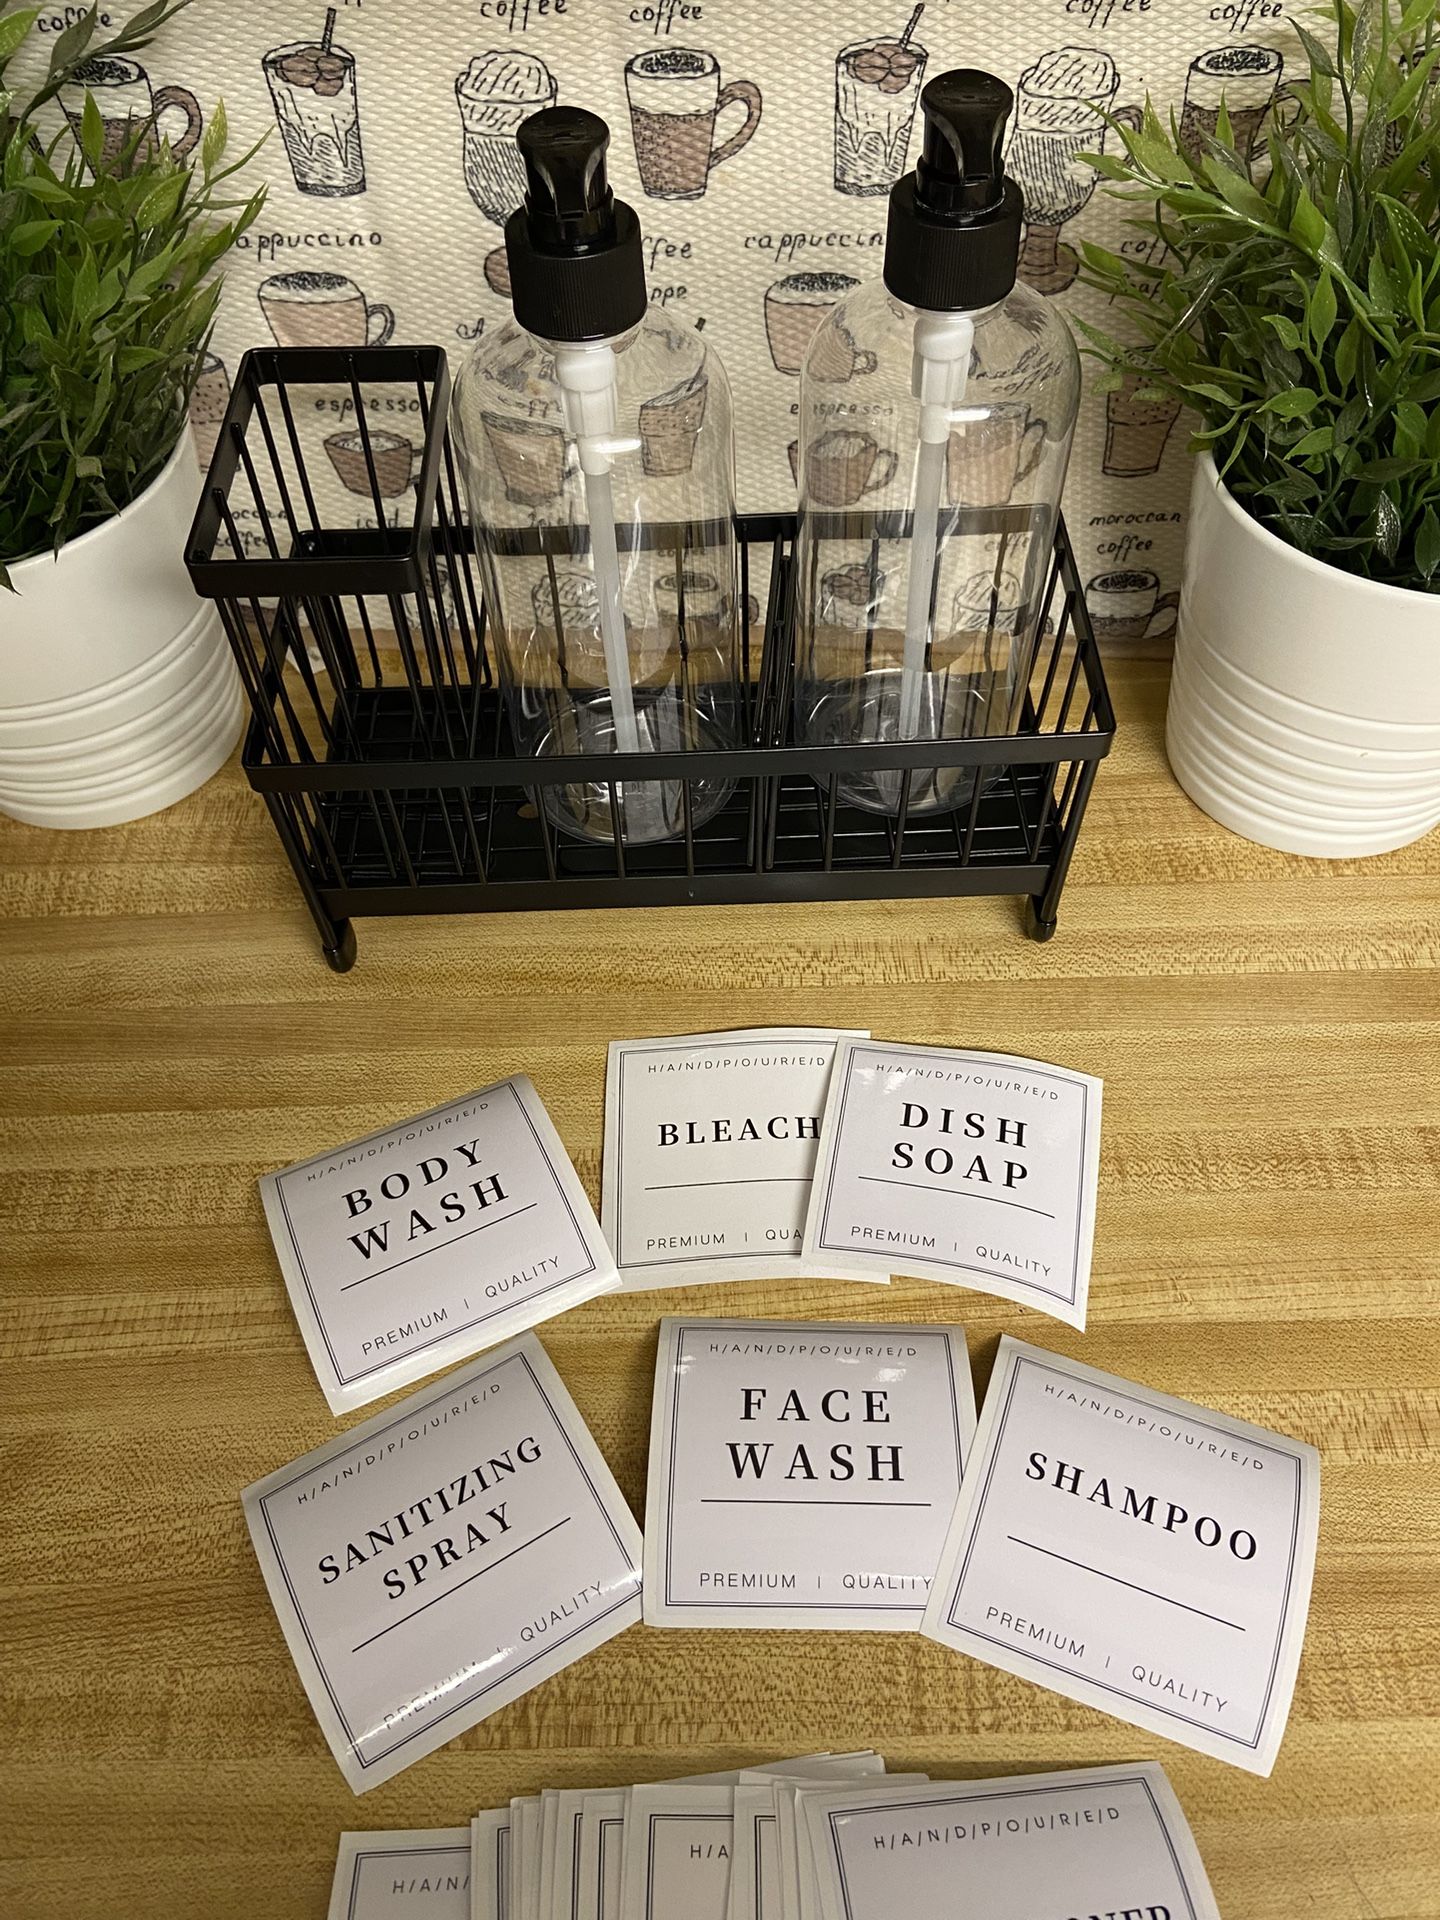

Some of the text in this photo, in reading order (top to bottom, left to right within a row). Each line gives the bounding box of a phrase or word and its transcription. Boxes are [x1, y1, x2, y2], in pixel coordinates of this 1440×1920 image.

[37, 7, 112, 33] cofe
[480, 0, 568, 32] coffee
[629, 0, 703, 35] coffee
[1209, 0, 1283, 33] coffee
[235, 228, 382, 262] appuccino
[744, 229, 884, 263] cappuccin
[314, 398, 420, 422] espesso
[1089, 512, 1181, 526] moroccan
[1096, 535, 1152, 562] coffee
[648, 1056, 825, 1074] H/A/N/D/P/O/U/R/E/D
[657, 1116, 821, 1147] BLEACH
[899, 1102, 1028, 1148] DISH
[342, 1138, 484, 1219] BODY
[891, 1142, 1028, 1189] SOAP
[347, 1173, 509, 1260] WASH
[647, 1233, 726, 1250] PREMIUM
[851, 1226, 1052, 1277] PREMIUM QUALITY
[361, 1256, 560, 1356] PREMIUM QUALITY
[710, 1343, 917, 1358] H/A/N/D/P/O/U/R/E/D
[739, 1388, 890, 1423] FACE
[726, 1443, 904, 1481] WASH
[318, 1436, 543, 1584] SANITIZING
[1025, 1452, 1258, 1561] SHAMPOO
[382, 1502, 513, 1600] SPRAY
[700, 1572, 796, 1588] PREMIUM
[520, 1581, 603, 1643] QUALITY
[986, 1606, 1229, 1714] PREMIUM QUALITY
